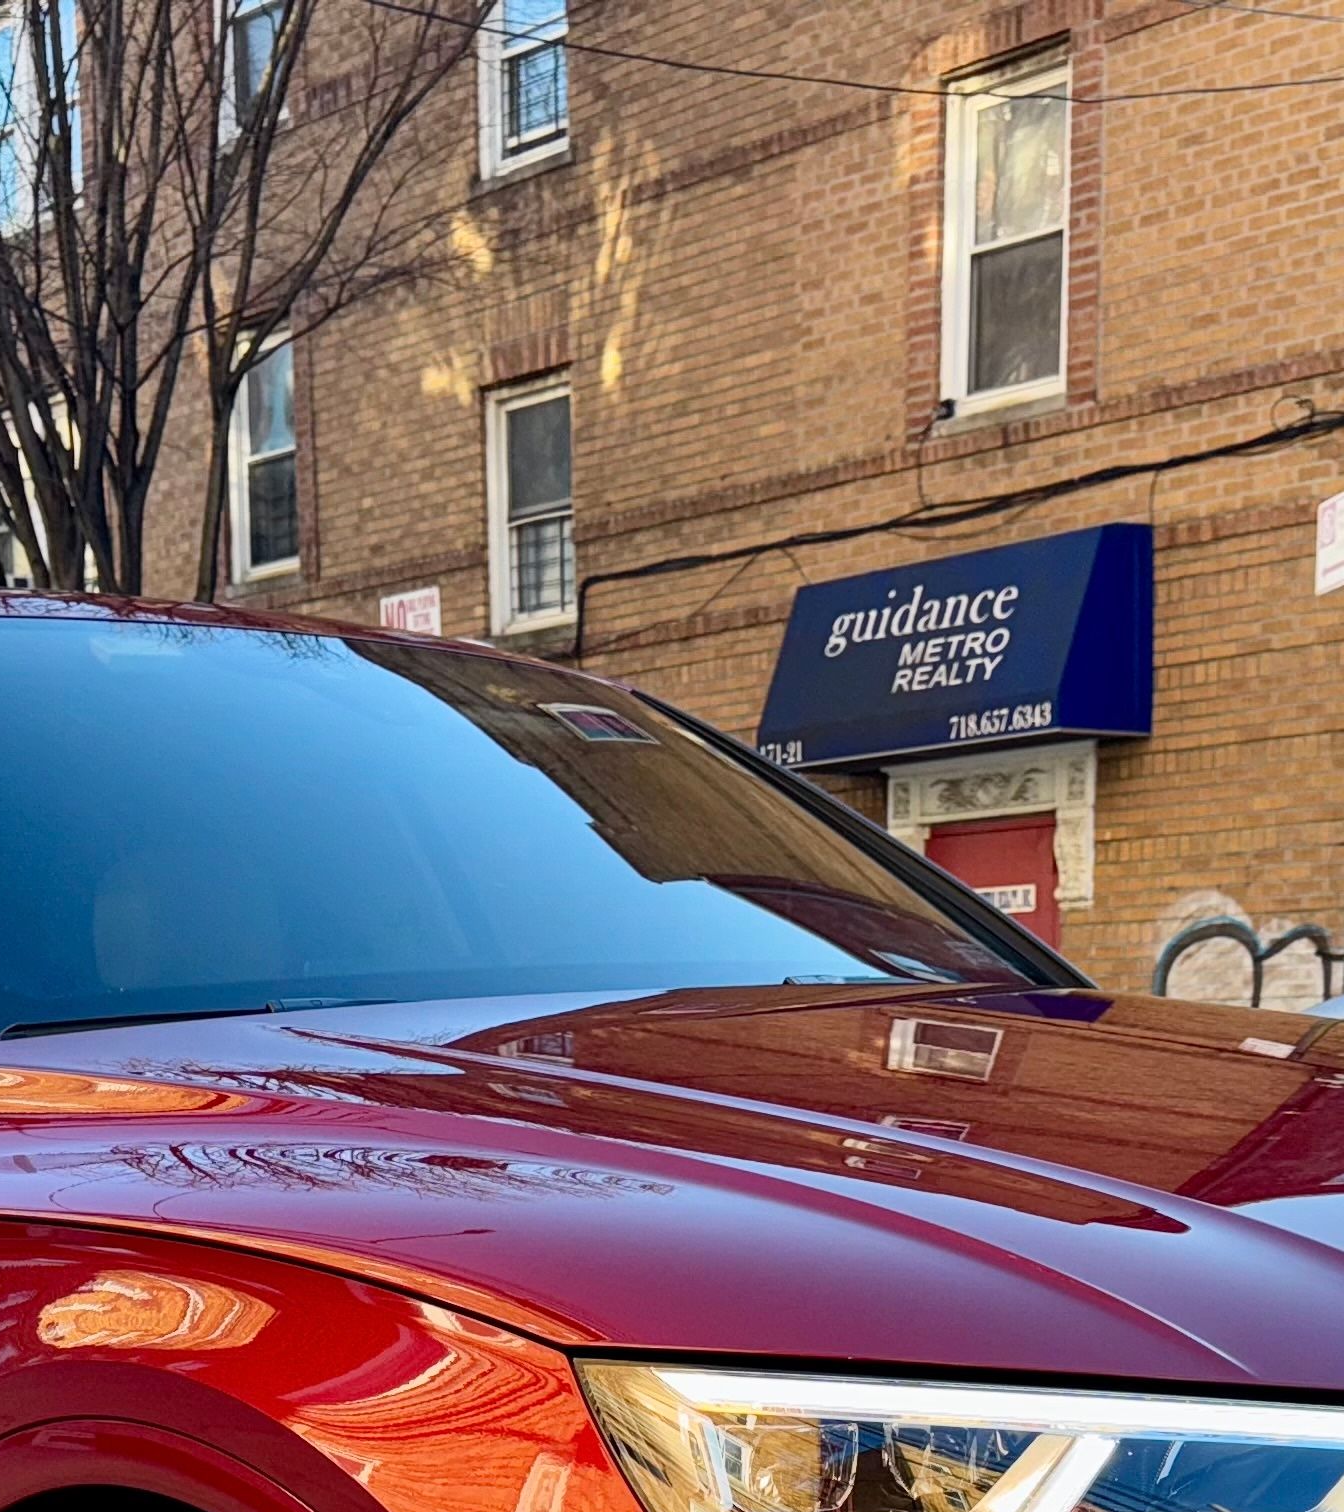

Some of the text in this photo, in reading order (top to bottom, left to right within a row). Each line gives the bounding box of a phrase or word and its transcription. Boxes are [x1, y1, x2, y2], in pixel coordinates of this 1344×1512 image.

[823, 584, 1019, 658] guidance
[897, 627, 1011, 666] METRO
[891, 654, 1003, 694] REALTY
[949, 701, 1052, 740] 718.657.6343
